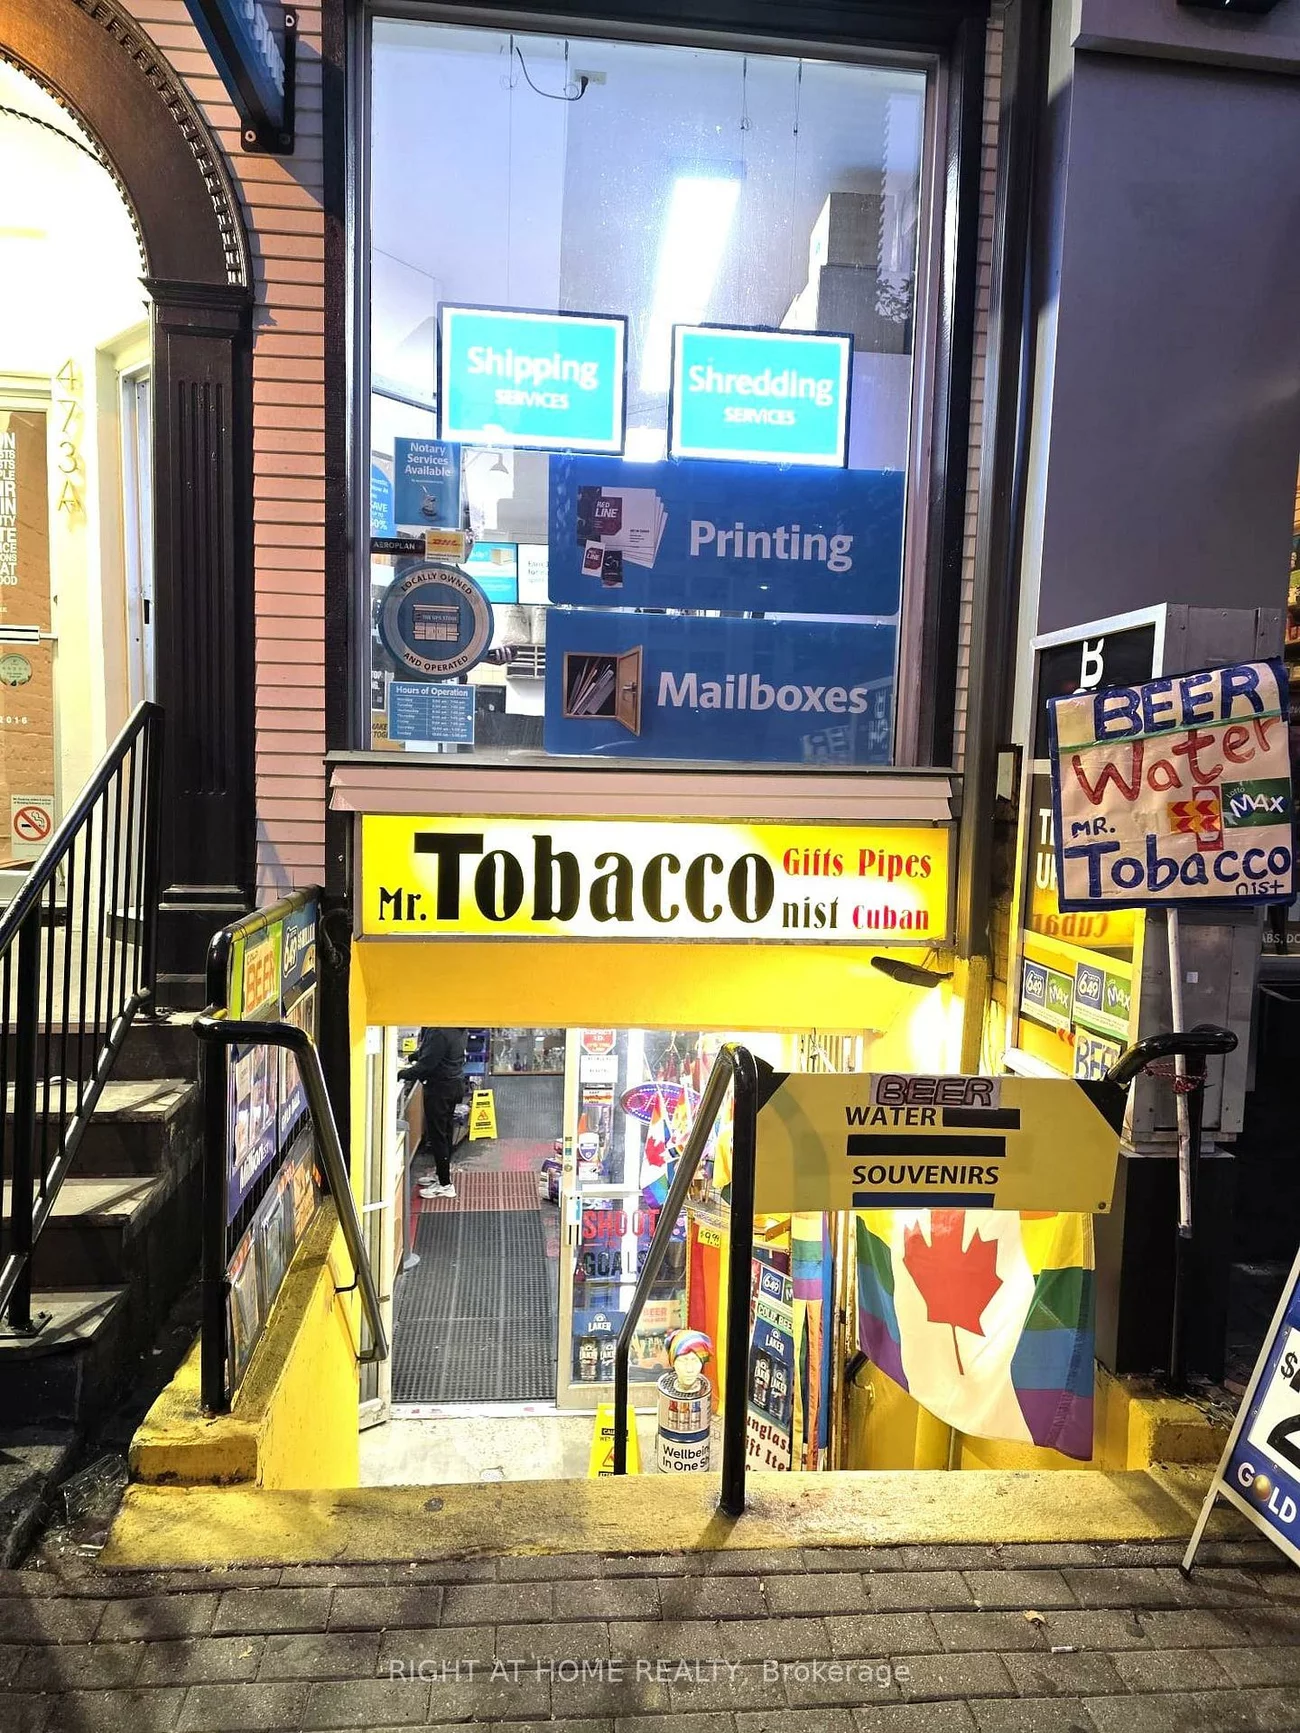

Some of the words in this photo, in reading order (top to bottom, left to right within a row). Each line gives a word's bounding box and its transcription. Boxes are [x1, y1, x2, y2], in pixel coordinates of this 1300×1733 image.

[467, 346, 598, 390] Shipping
[688, 365, 835, 407] Shredding
[494, 388, 569, 410] SERVICES
[723, 406, 796, 427] SERVICES
[406, 453, 449, 466] Services
[409, 442, 446, 457] Notary
[404, 464, 453, 477] Available
[594, 507, 619, 518] LINE
[373, 541, 416, 550] AEROPLAN
[690, 519, 853, 572] Printing
[401, 573, 437, 592] LOCALLY
[440, 573, 472, 595] OWNED
[403, 652, 422, 667] AND
[424, 655, 468, 671] OPERATED
[396, 686, 420, 695] Hours
[421, 686, 429, 695] of
[431, 687, 469, 698] Operation
[657, 671, 868, 714] Mailboxes
[1093, 665, 1265, 740] BEER
[1072, 717, 1281, 806] Water
[1230, 793, 1284, 819] MAX
[1071, 816, 1116, 840] MR.
[783, 846, 844, 878] Gifts
[858, 847, 931, 884] Pipes
[1064, 834, 1292, 899] Tobacco
[378, 886, 427, 922] Mr.
[414, 831, 776, 923] Tobacco
[781, 895, 839, 929] nist
[852, 905, 930, 931] Cuban
[876, 1074, 994, 1106] BEER
[846, 1106, 937, 1127] WATER
[852, 1165, 1000, 1185] SOUVENIRS
[663, 1456, 672, 1469] In
[674, 1460, 699, 1472] One
